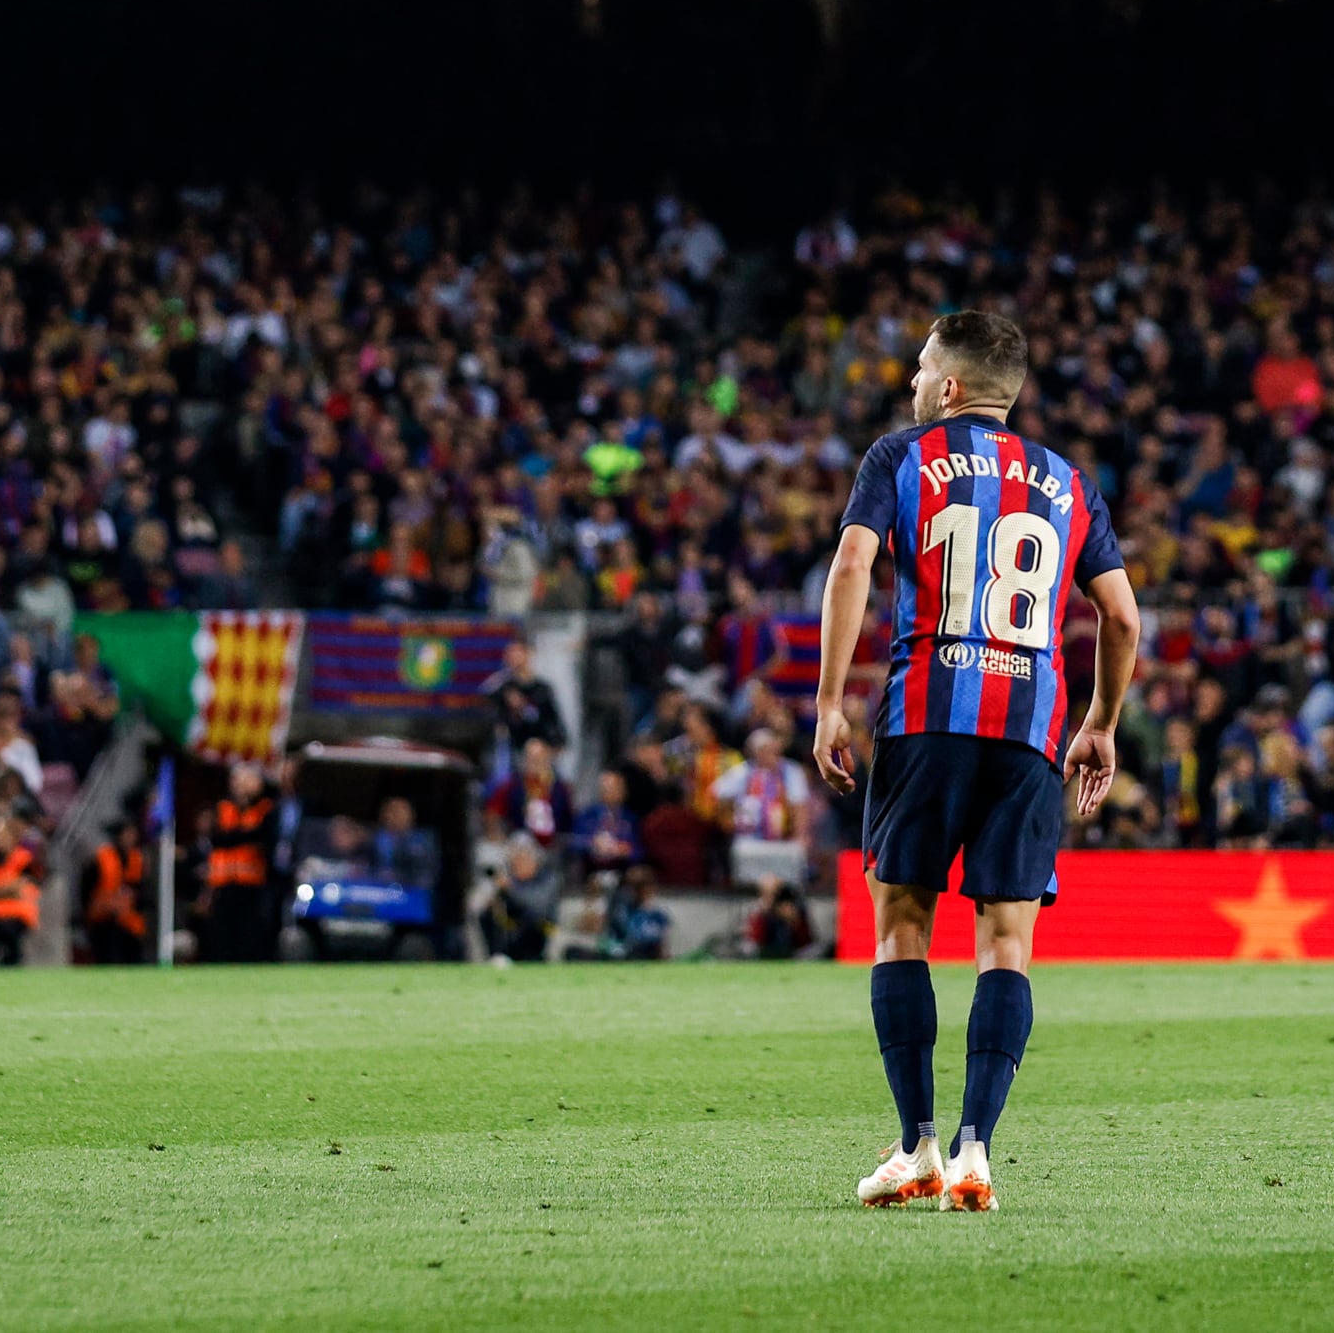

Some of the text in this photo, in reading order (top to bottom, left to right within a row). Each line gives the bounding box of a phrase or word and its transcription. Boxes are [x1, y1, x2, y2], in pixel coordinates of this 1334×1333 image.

[918, 453, 1074, 516] JORDI ALBA
[921, 503, 1061, 649] 18
[977, 658, 1032, 676] ACNUR
[978, 646, 1031, 666] UNHCR
